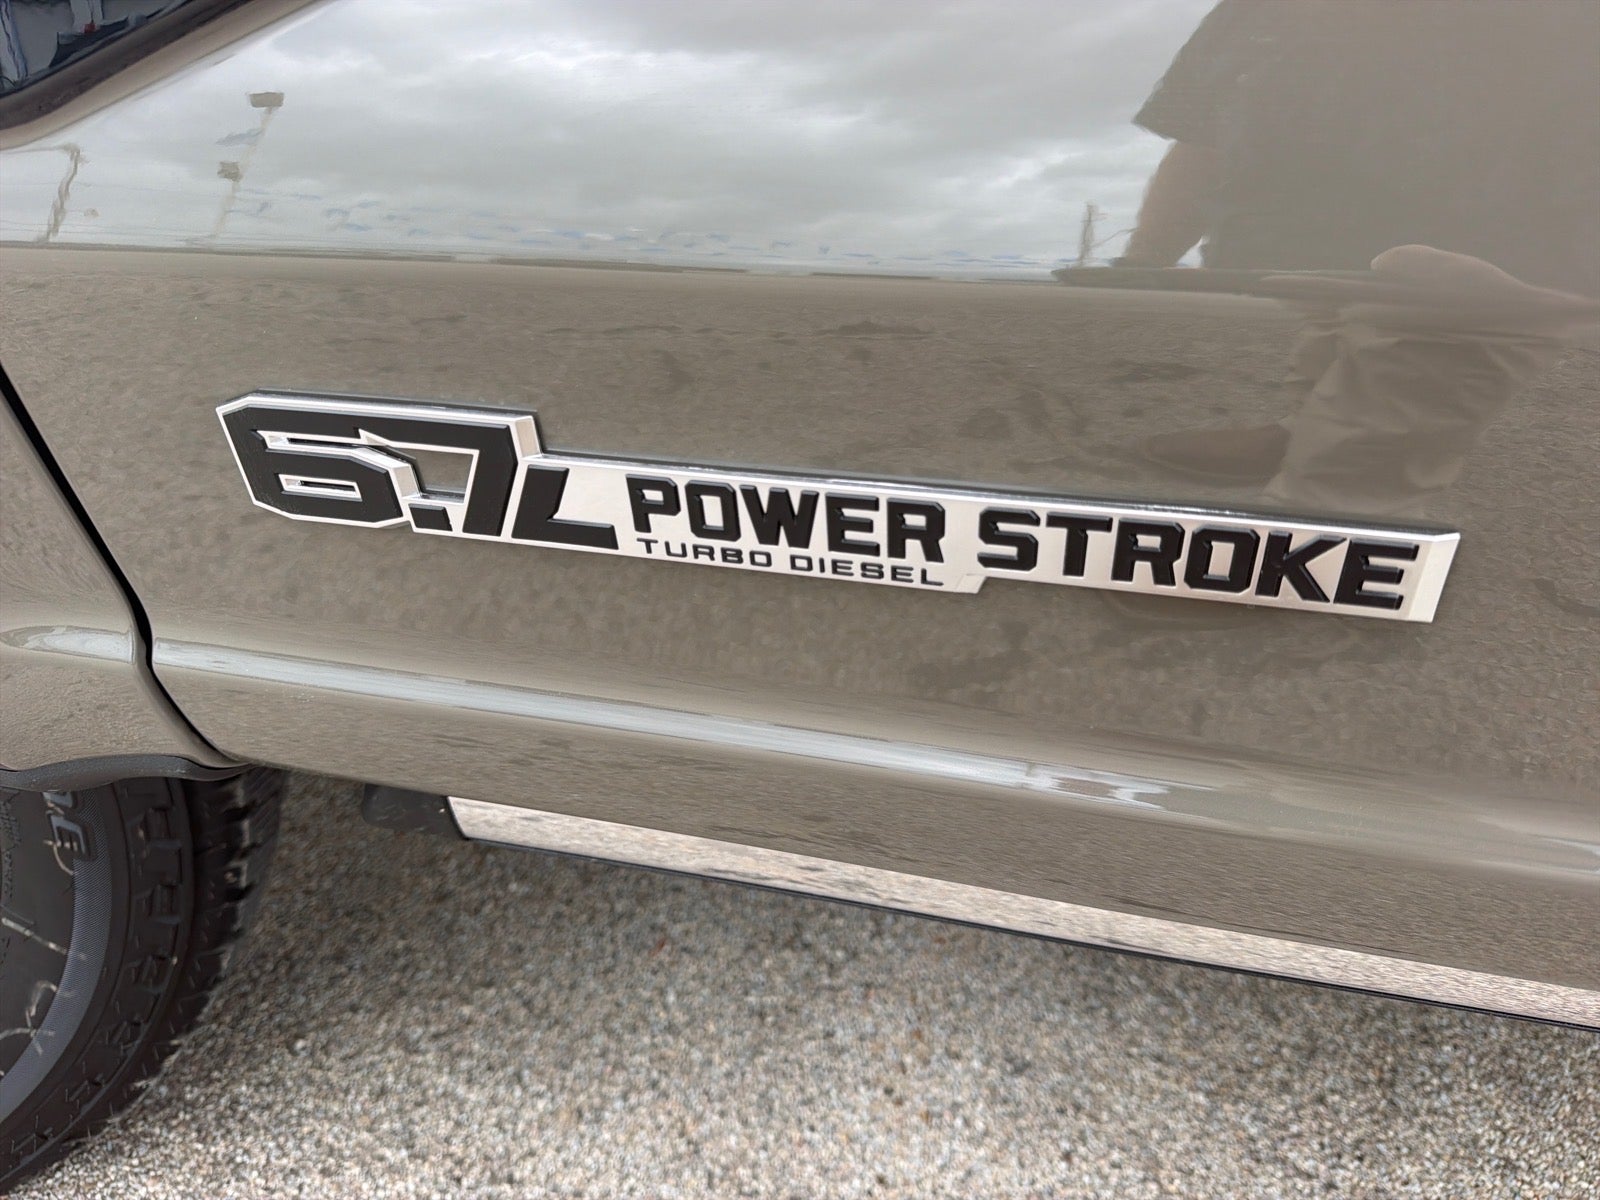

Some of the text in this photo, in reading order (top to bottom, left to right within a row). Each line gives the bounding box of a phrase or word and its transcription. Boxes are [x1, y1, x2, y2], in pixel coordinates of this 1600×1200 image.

[220, 404, 1420, 611] 6.7L POWER STROKE
[636, 537, 945, 587] TURBO DIESEL
